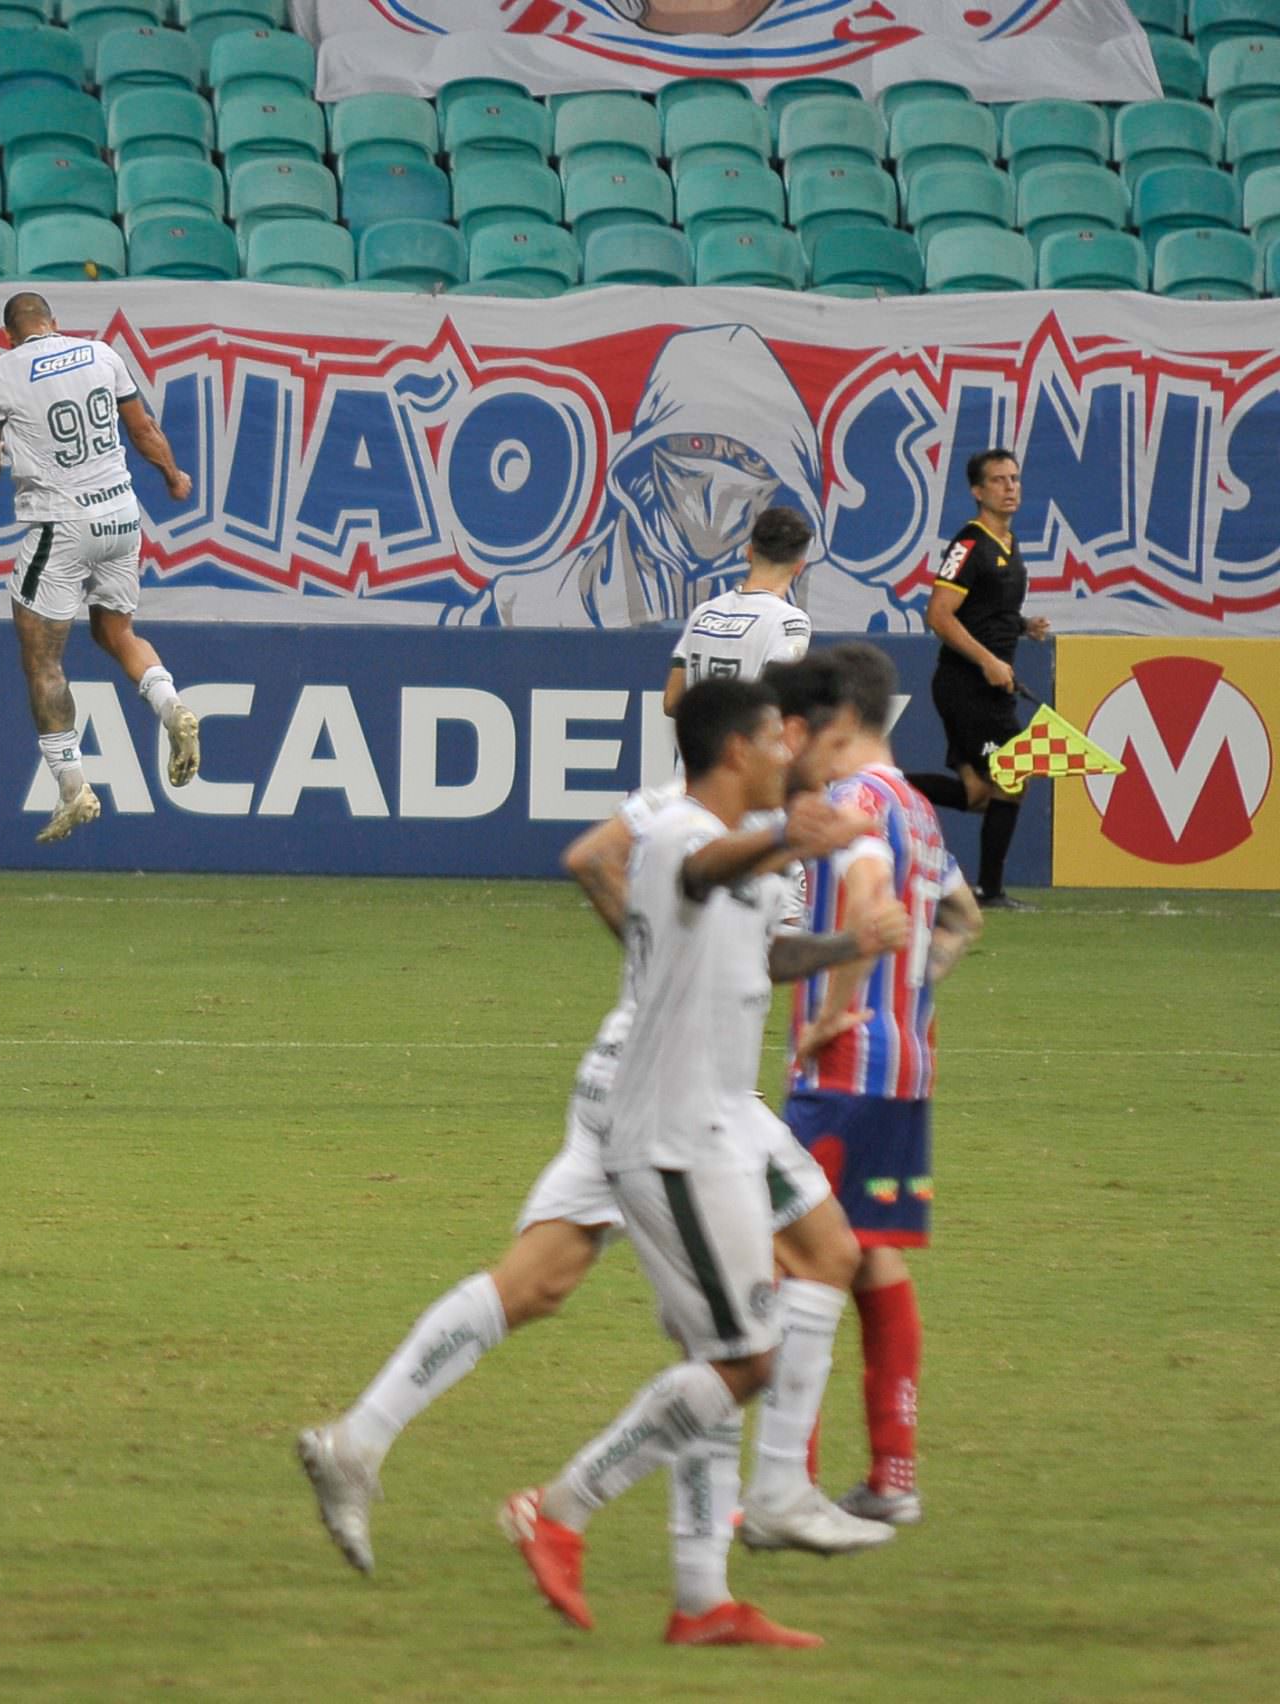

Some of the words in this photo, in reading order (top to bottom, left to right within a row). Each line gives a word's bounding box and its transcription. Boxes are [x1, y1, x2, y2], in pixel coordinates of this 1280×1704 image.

[47, 386, 117, 468] 99
[75, 478, 132, 508] Unime
[90, 519, 141, 538] Unime
[23, 681, 912, 824] ACADE
